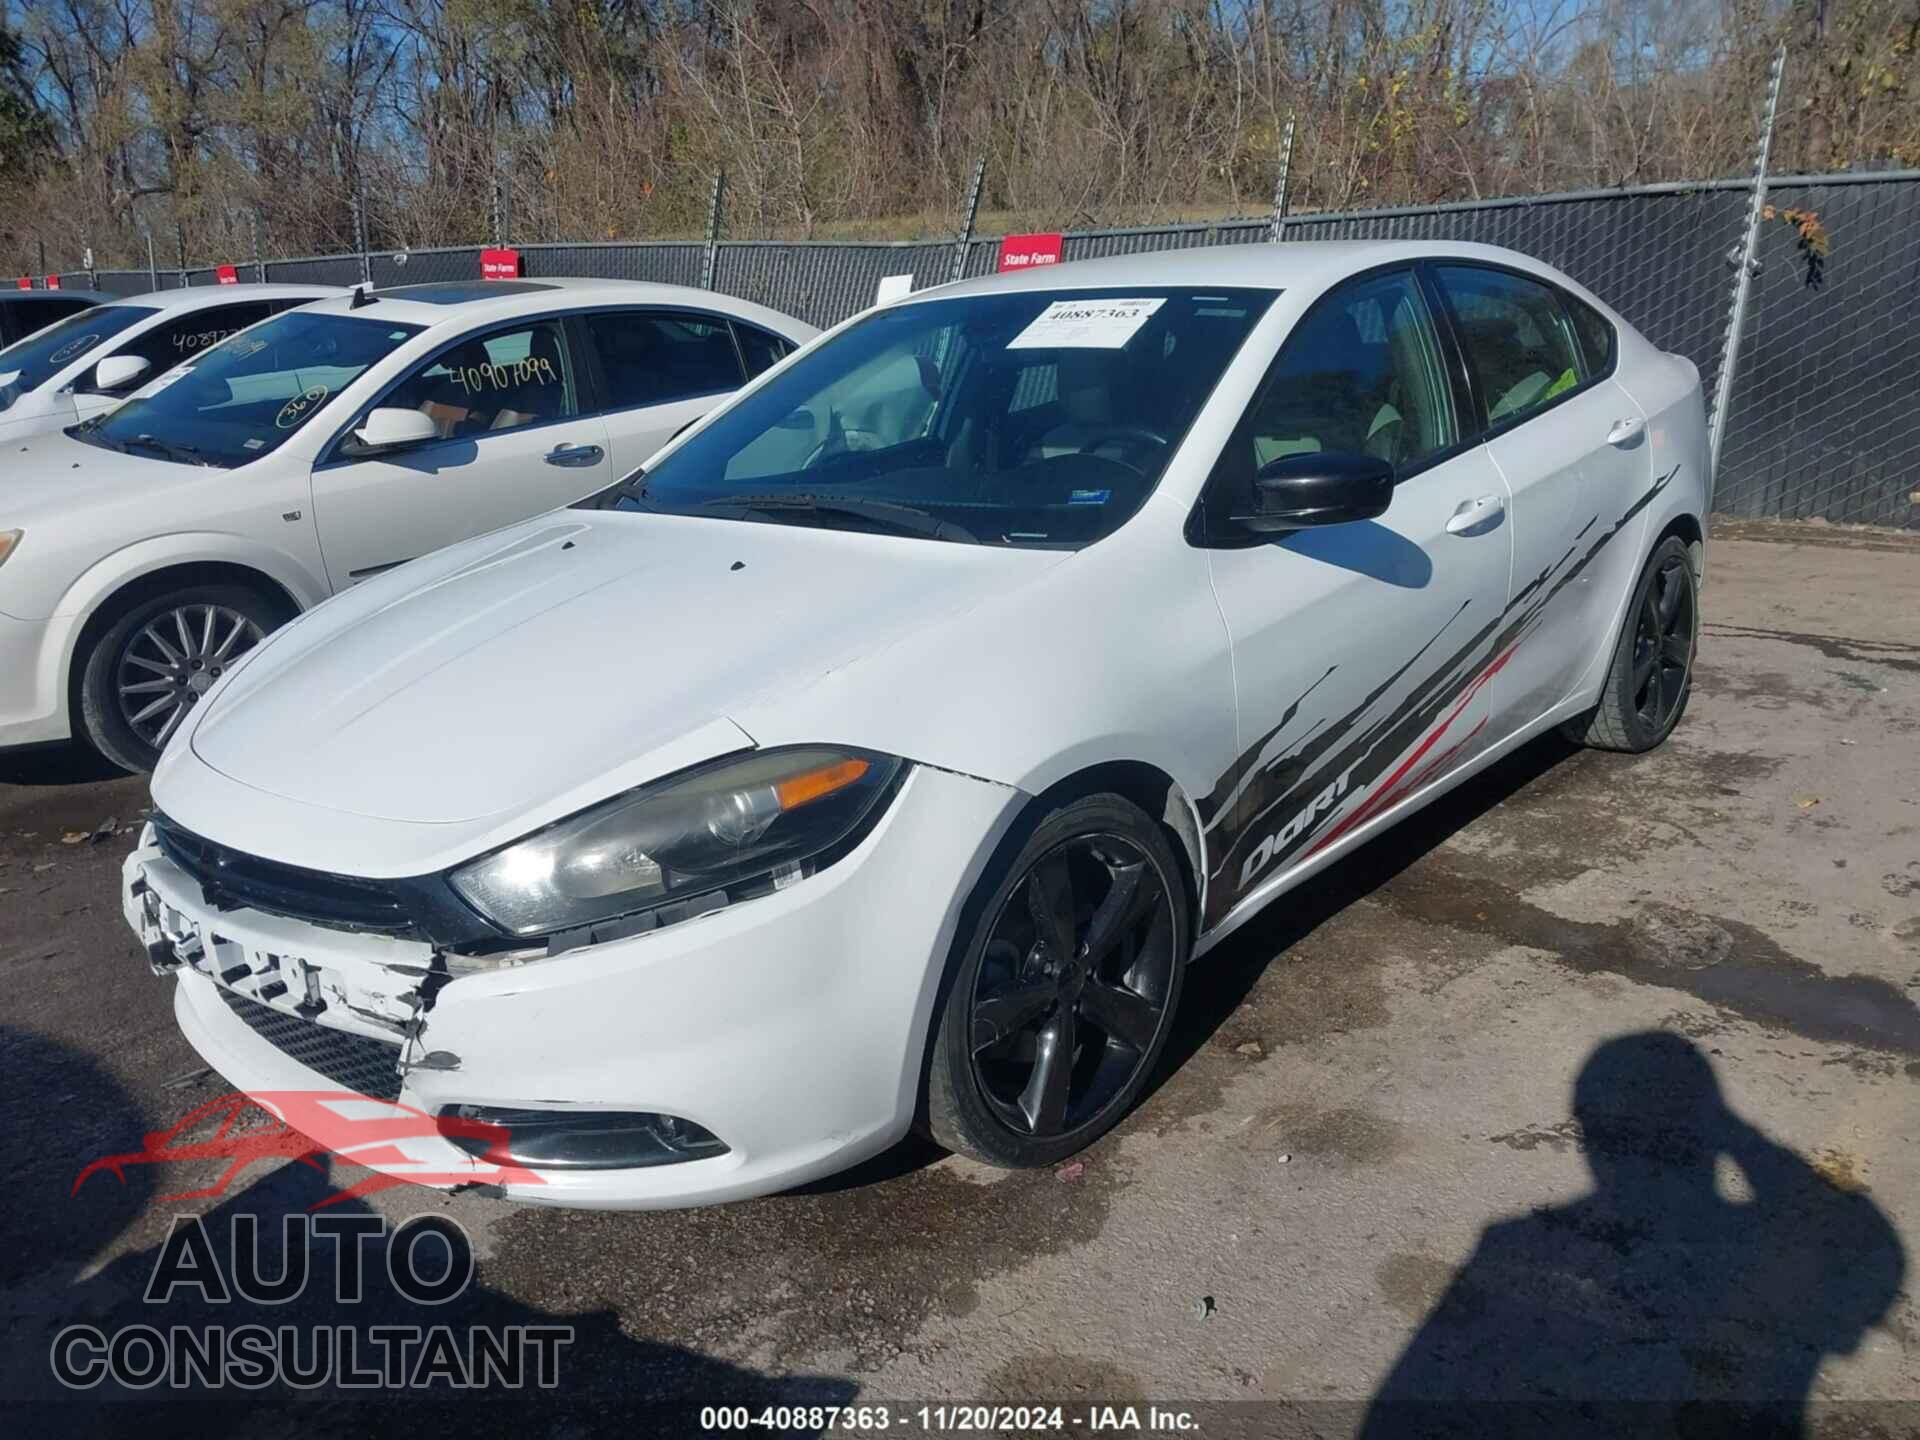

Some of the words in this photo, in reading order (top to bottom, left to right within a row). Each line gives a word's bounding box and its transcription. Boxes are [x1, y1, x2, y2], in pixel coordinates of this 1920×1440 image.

[1003, 253, 1029, 266] State
[1031, 252, 1056, 264] Farm
[1049, 308, 1140, 320] 40887363
